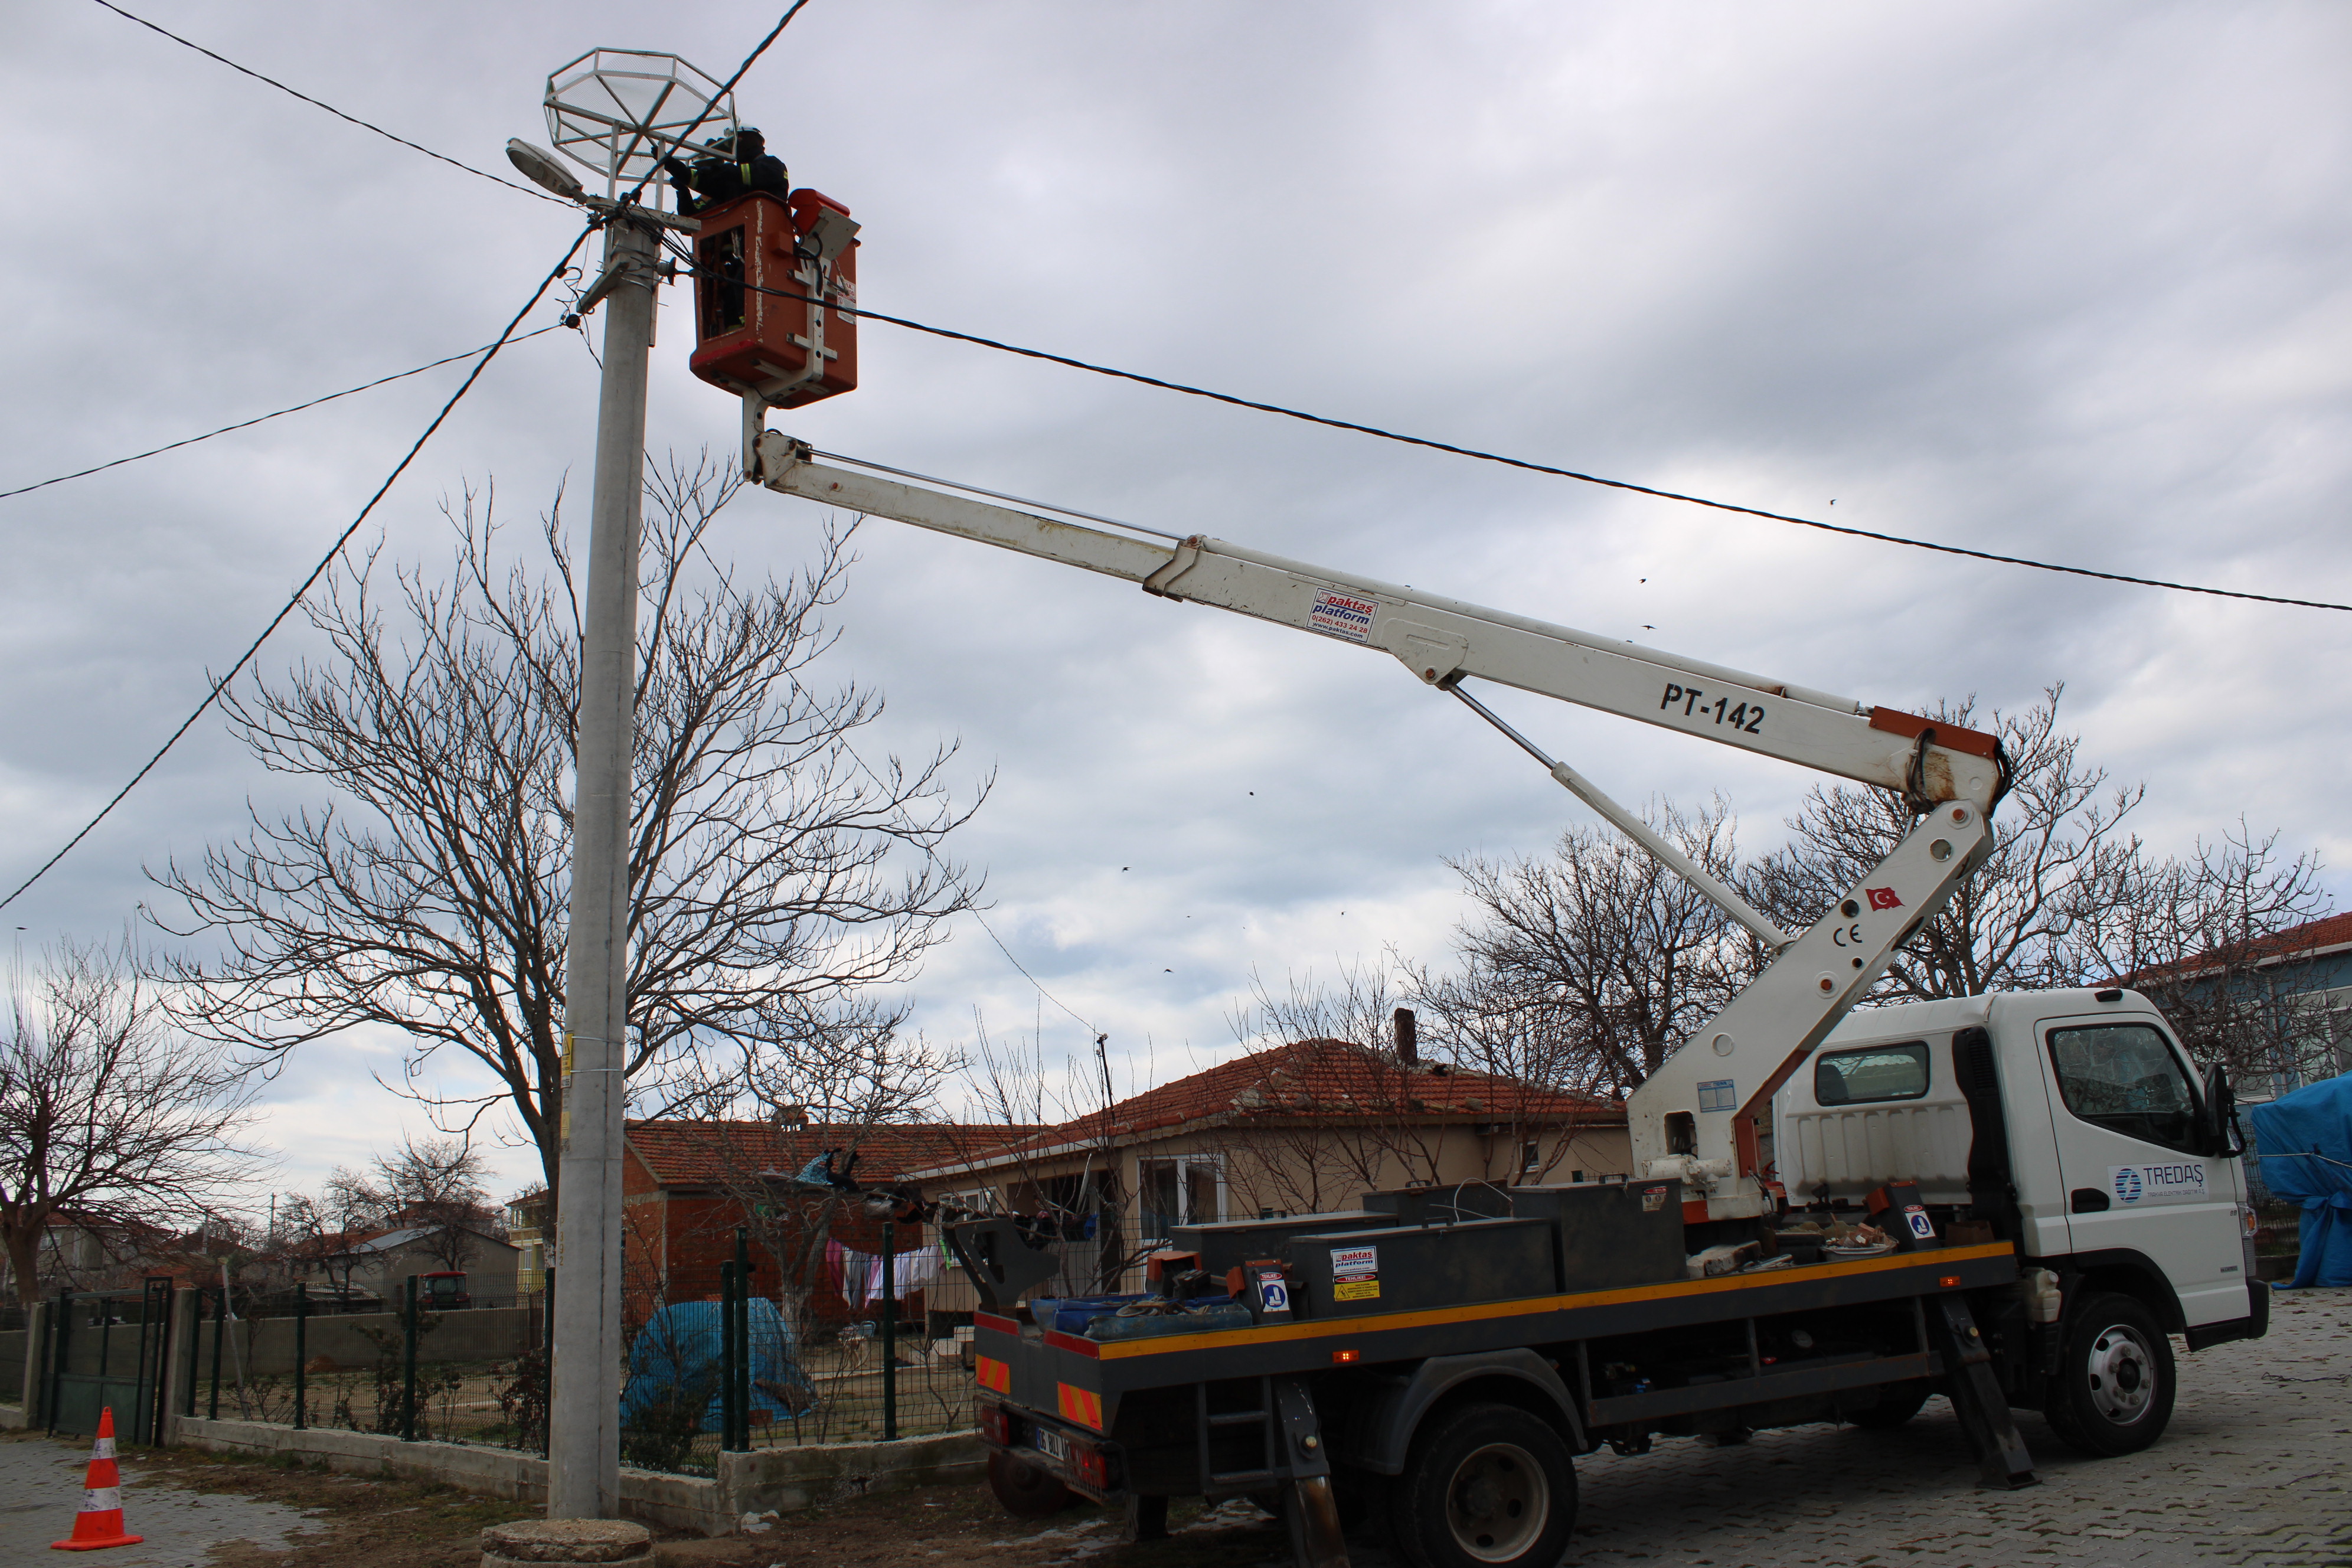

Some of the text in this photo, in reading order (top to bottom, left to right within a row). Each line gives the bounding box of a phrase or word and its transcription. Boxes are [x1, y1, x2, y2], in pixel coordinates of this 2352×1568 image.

[1312, 605, 1370, 625] platform
[1328, 596, 1373, 615] paktaş
[1312, 615, 1333, 625] 0(262)
[1312, 622, 1363, 638] www.paktas.com
[1660, 682, 1765, 734] PT-142
[1832, 923, 1863, 947] CE
[2143, 1164, 2203, 1187] TREDAŞ
[1335, 1259, 1373, 1268] platform
[1341, 1250, 1373, 1261] paktaş
[1039, 1429, 1046, 1450] 06
